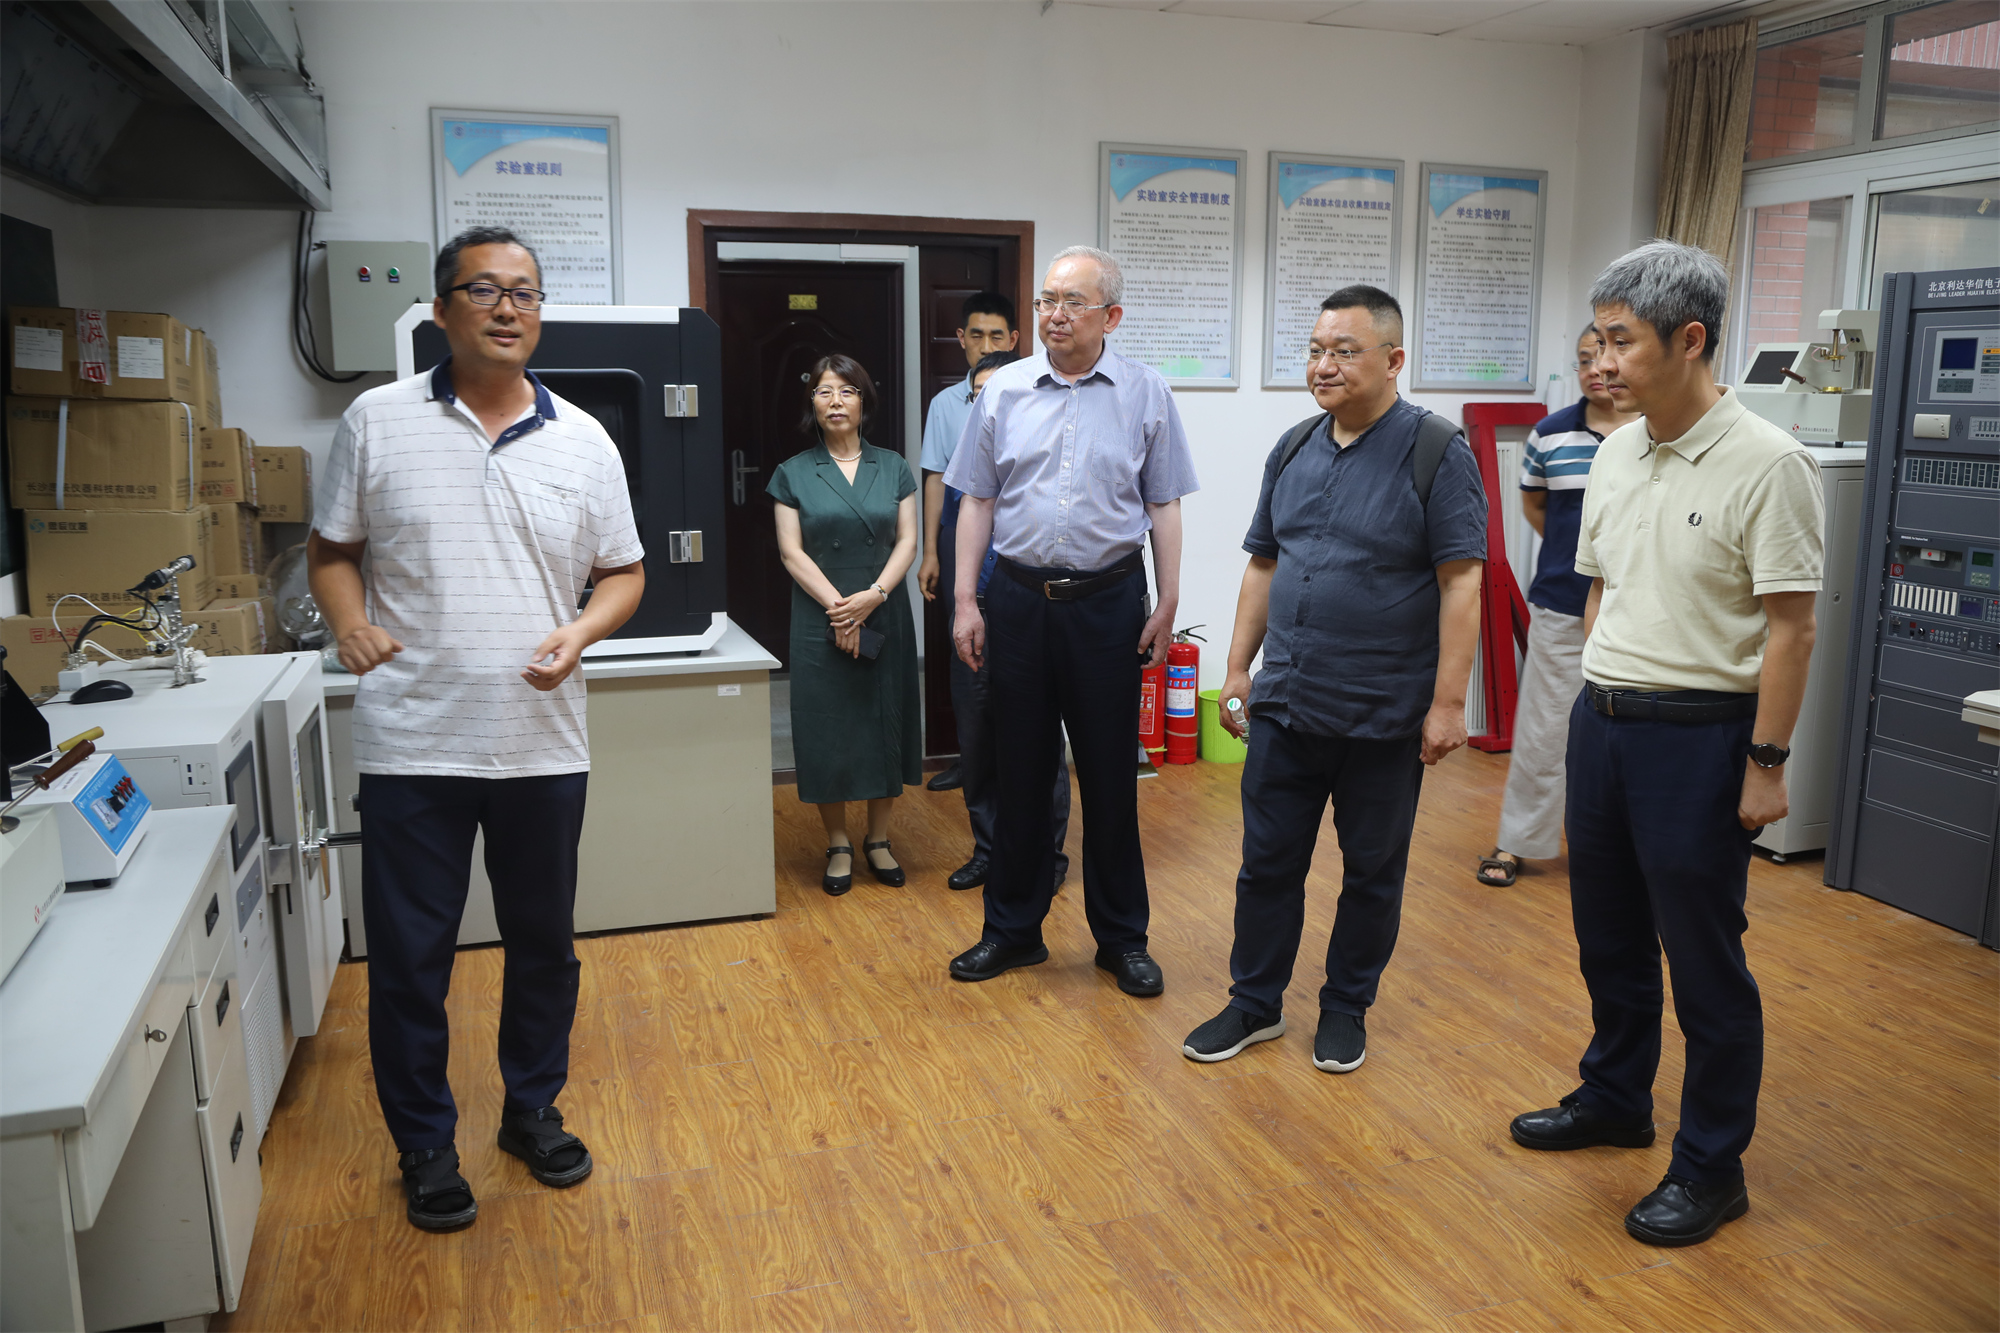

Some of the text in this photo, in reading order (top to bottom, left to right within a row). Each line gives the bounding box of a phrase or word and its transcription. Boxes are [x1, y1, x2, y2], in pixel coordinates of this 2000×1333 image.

[495, 160, 562, 177] 实验室规则
[1136, 189, 1231, 206] 实验室安全管理制度
[1298, 195, 1391, 211] 实验室基本信息收集整理规定
[1456, 206, 1511, 222] 学生实验守则
[1928, 277, 2000, 292] 北京利达华信电子
